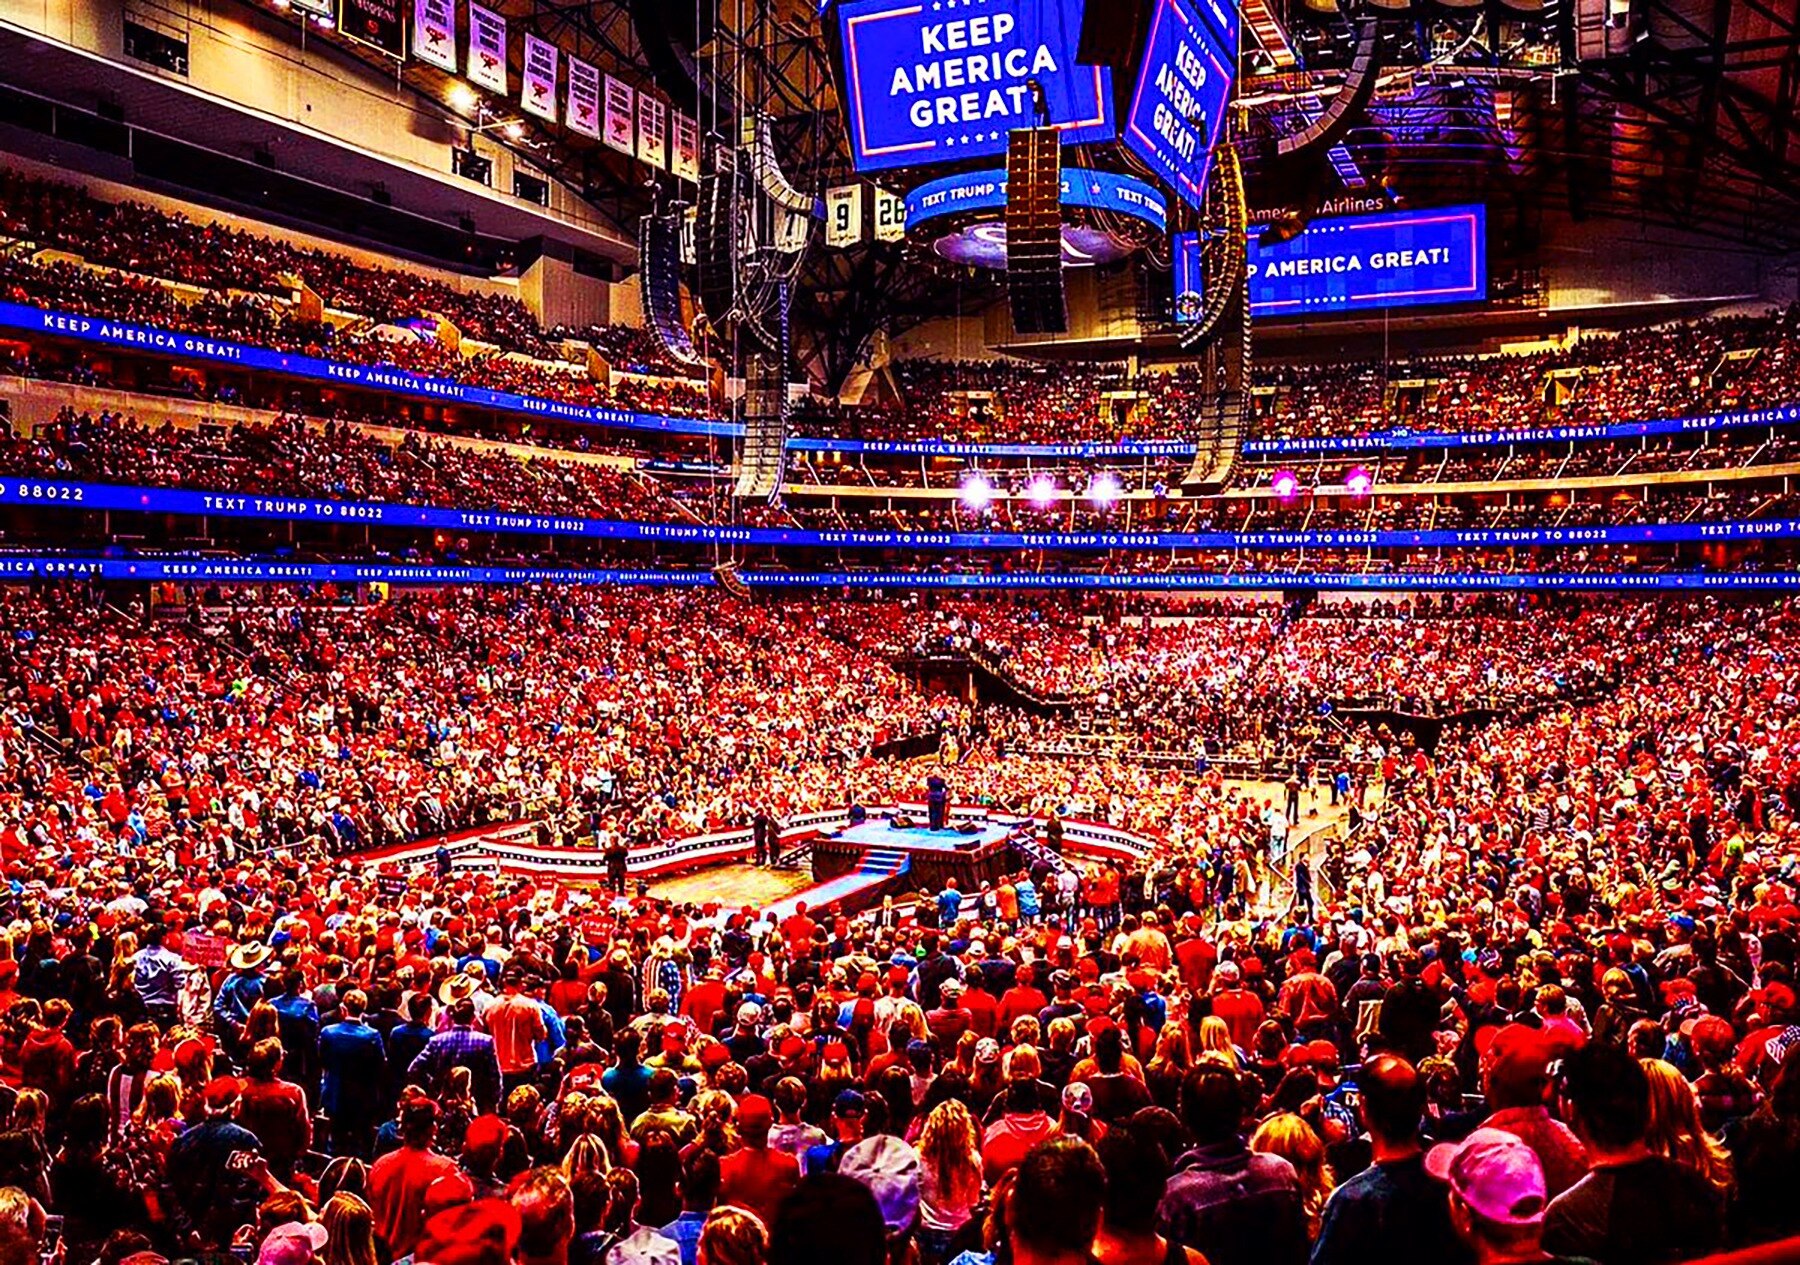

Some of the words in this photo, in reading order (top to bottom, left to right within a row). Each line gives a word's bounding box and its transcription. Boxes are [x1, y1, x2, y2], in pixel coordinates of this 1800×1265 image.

[922, 14, 1015, 56] KEEP
[890, 44, 1057, 97] AMERICA
[1176, 40, 1206, 91] KEEP
[922, 191, 946, 207] TEXT
[951, 183, 995, 200] TRUMP
[1116, 187, 1142, 204] TEXT
[1322, 197, 1384, 214] Airlines
[837, 204, 849, 231] 9
[1265, 254, 1362, 278] AMERICA
[1370, 248, 1449, 270] GREAT!
[45, 314, 90, 332] KEEP
[100, 322, 176, 346] AMERICA
[185, 340, 241, 358] GREAT!
[329, 365, 360, 378] KEEP
[367, 374, 419, 388] AMERICA
[1683, 417, 1715, 428] KEEP
[1722, 410, 1783, 425] AMERICA
[1462, 434, 1492, 443] KEEP
[1498, 430, 1553, 441] AMERICA
[19, 485, 82, 500] 88022
[204, 497, 245, 509] TEXT
[255, 500, 306, 512] TRUMP
[315, 504, 332, 515] TO
[341, 506, 382, 518] 88022
[1701, 525, 1731, 534] TEXT
[1739, 523, 1781, 533] TRUMP
